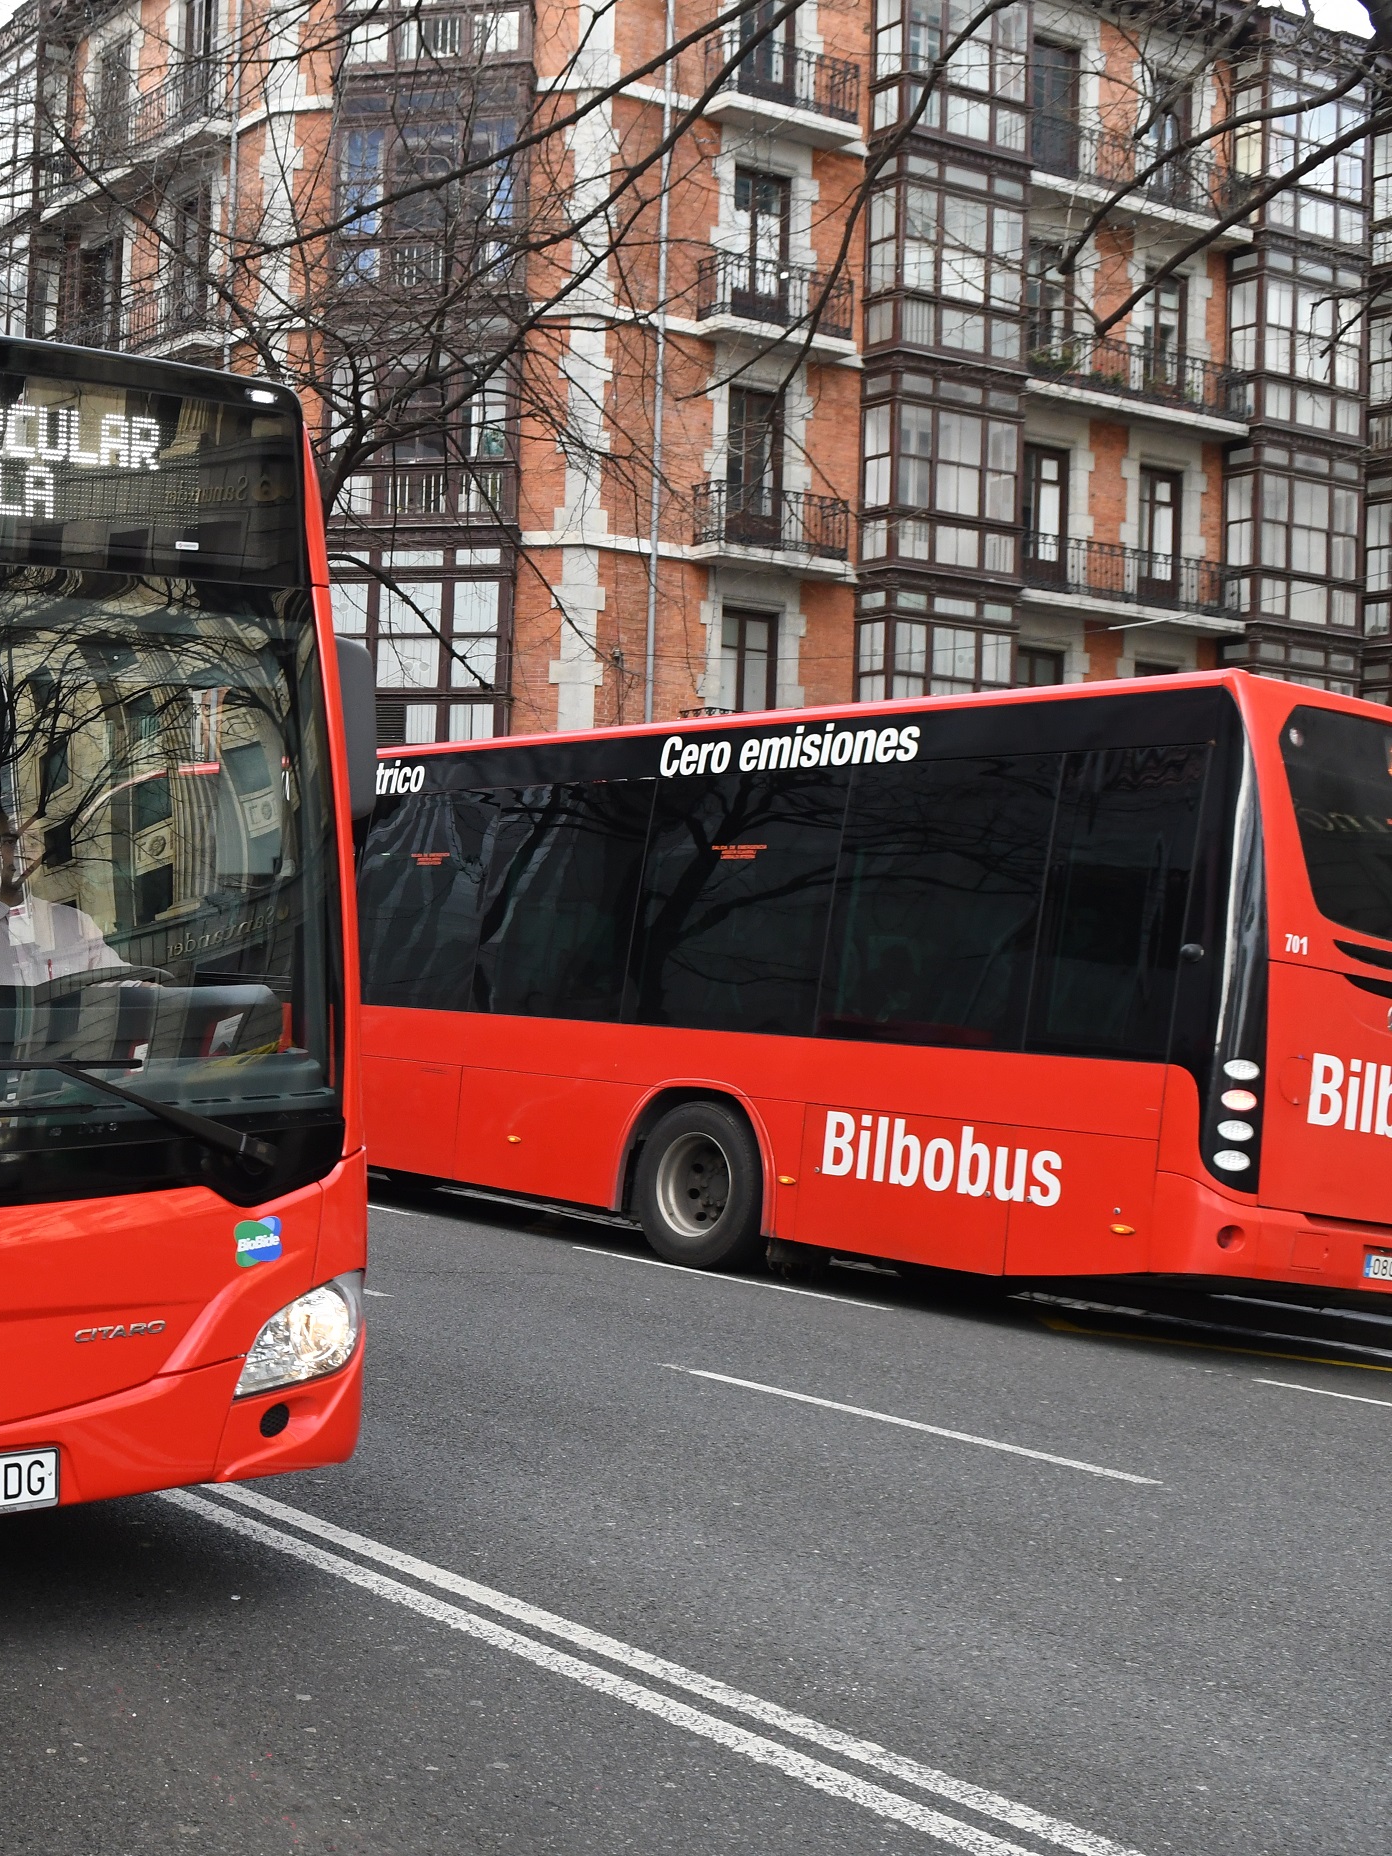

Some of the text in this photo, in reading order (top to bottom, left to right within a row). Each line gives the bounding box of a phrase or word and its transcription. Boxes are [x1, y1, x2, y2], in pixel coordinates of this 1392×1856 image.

[659, 722, 921, 777] Cero emisiones
[1285, 933, 1308, 956] 701
[821, 1110, 1063, 1207] Bilbobus
[74, 1320, 167, 1343] CITARO
